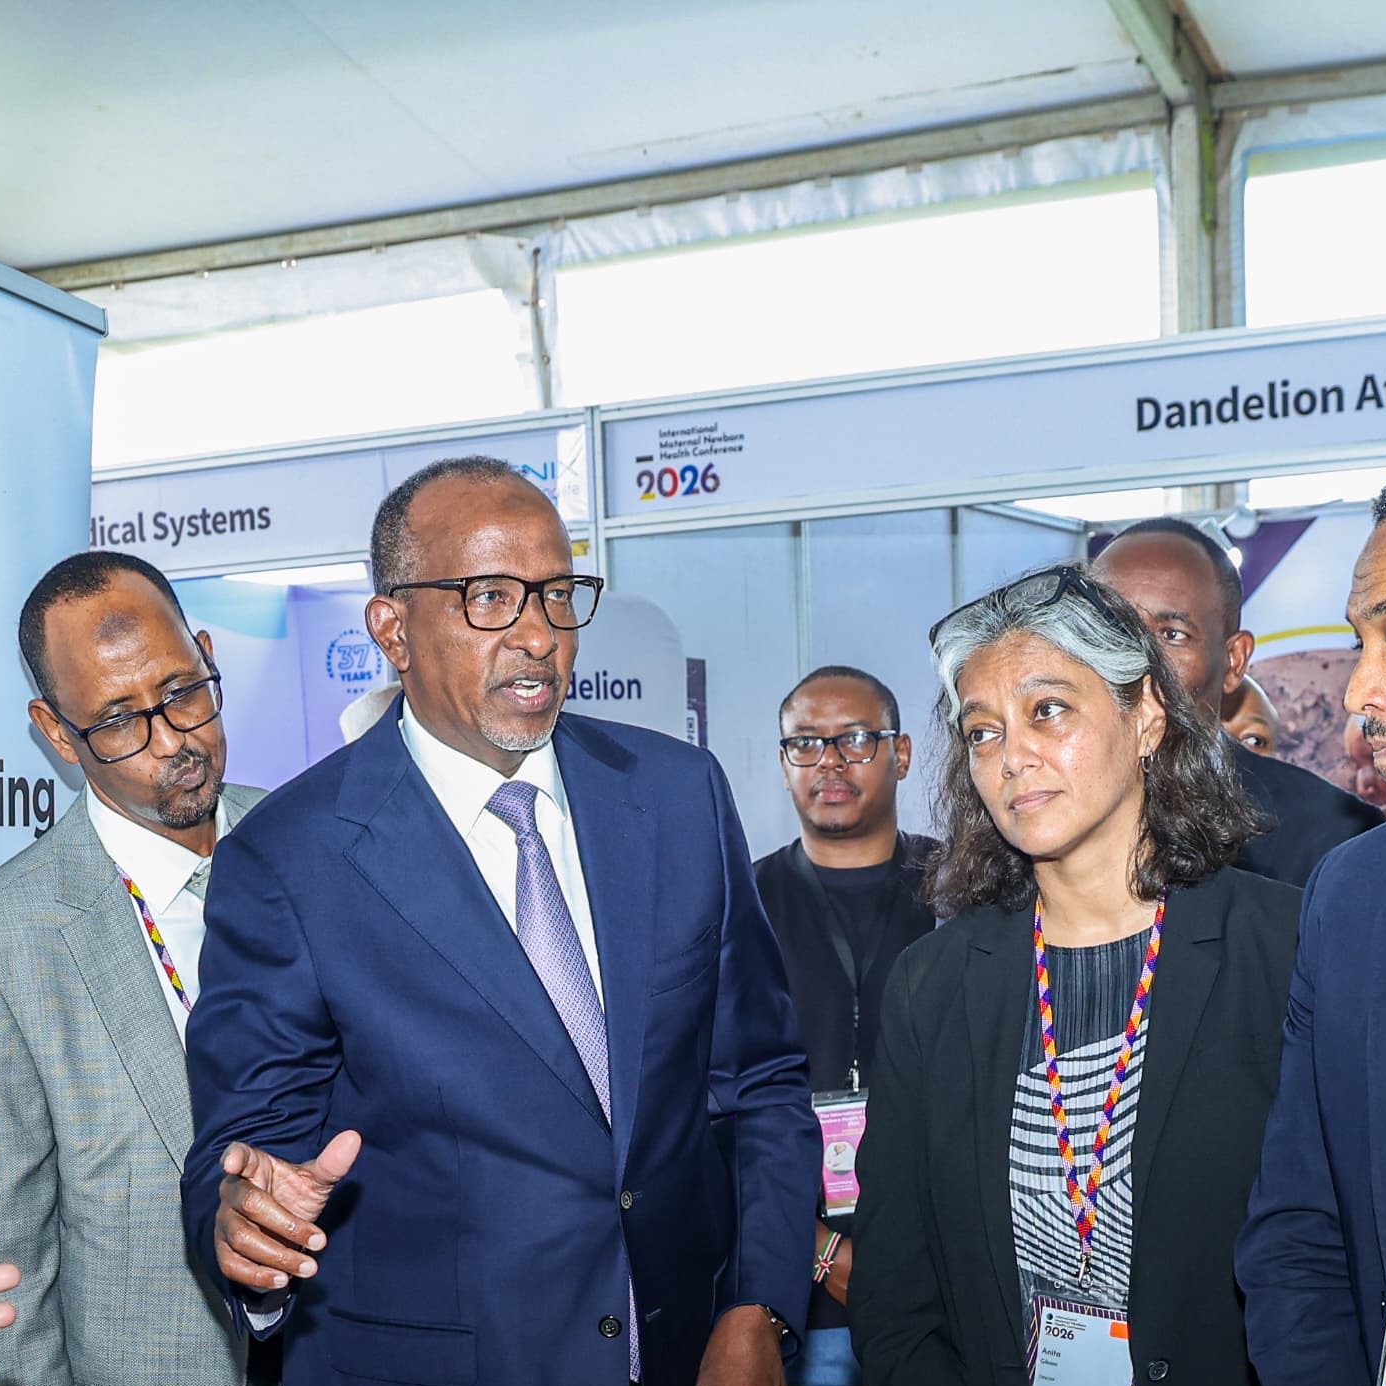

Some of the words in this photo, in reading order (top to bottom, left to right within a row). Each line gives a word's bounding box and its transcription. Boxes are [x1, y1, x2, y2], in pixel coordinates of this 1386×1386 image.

[1136, 378, 1344, 433] Dandelion
[659, 423, 718, 439] International
[660, 436, 701, 449] Maternal
[704, 433, 745, 445] Newborn
[660, 450, 690, 461] Health
[693, 444, 744, 456] Conference
[636, 463, 721, 500] 2026
[153, 506, 271, 547] Systems
[337, 643, 370, 670] 37
[340, 670, 372, 682] YEARS
[1044, 1325, 1075, 1340] 2026
[1041, 1346, 1061, 1358] Anita
